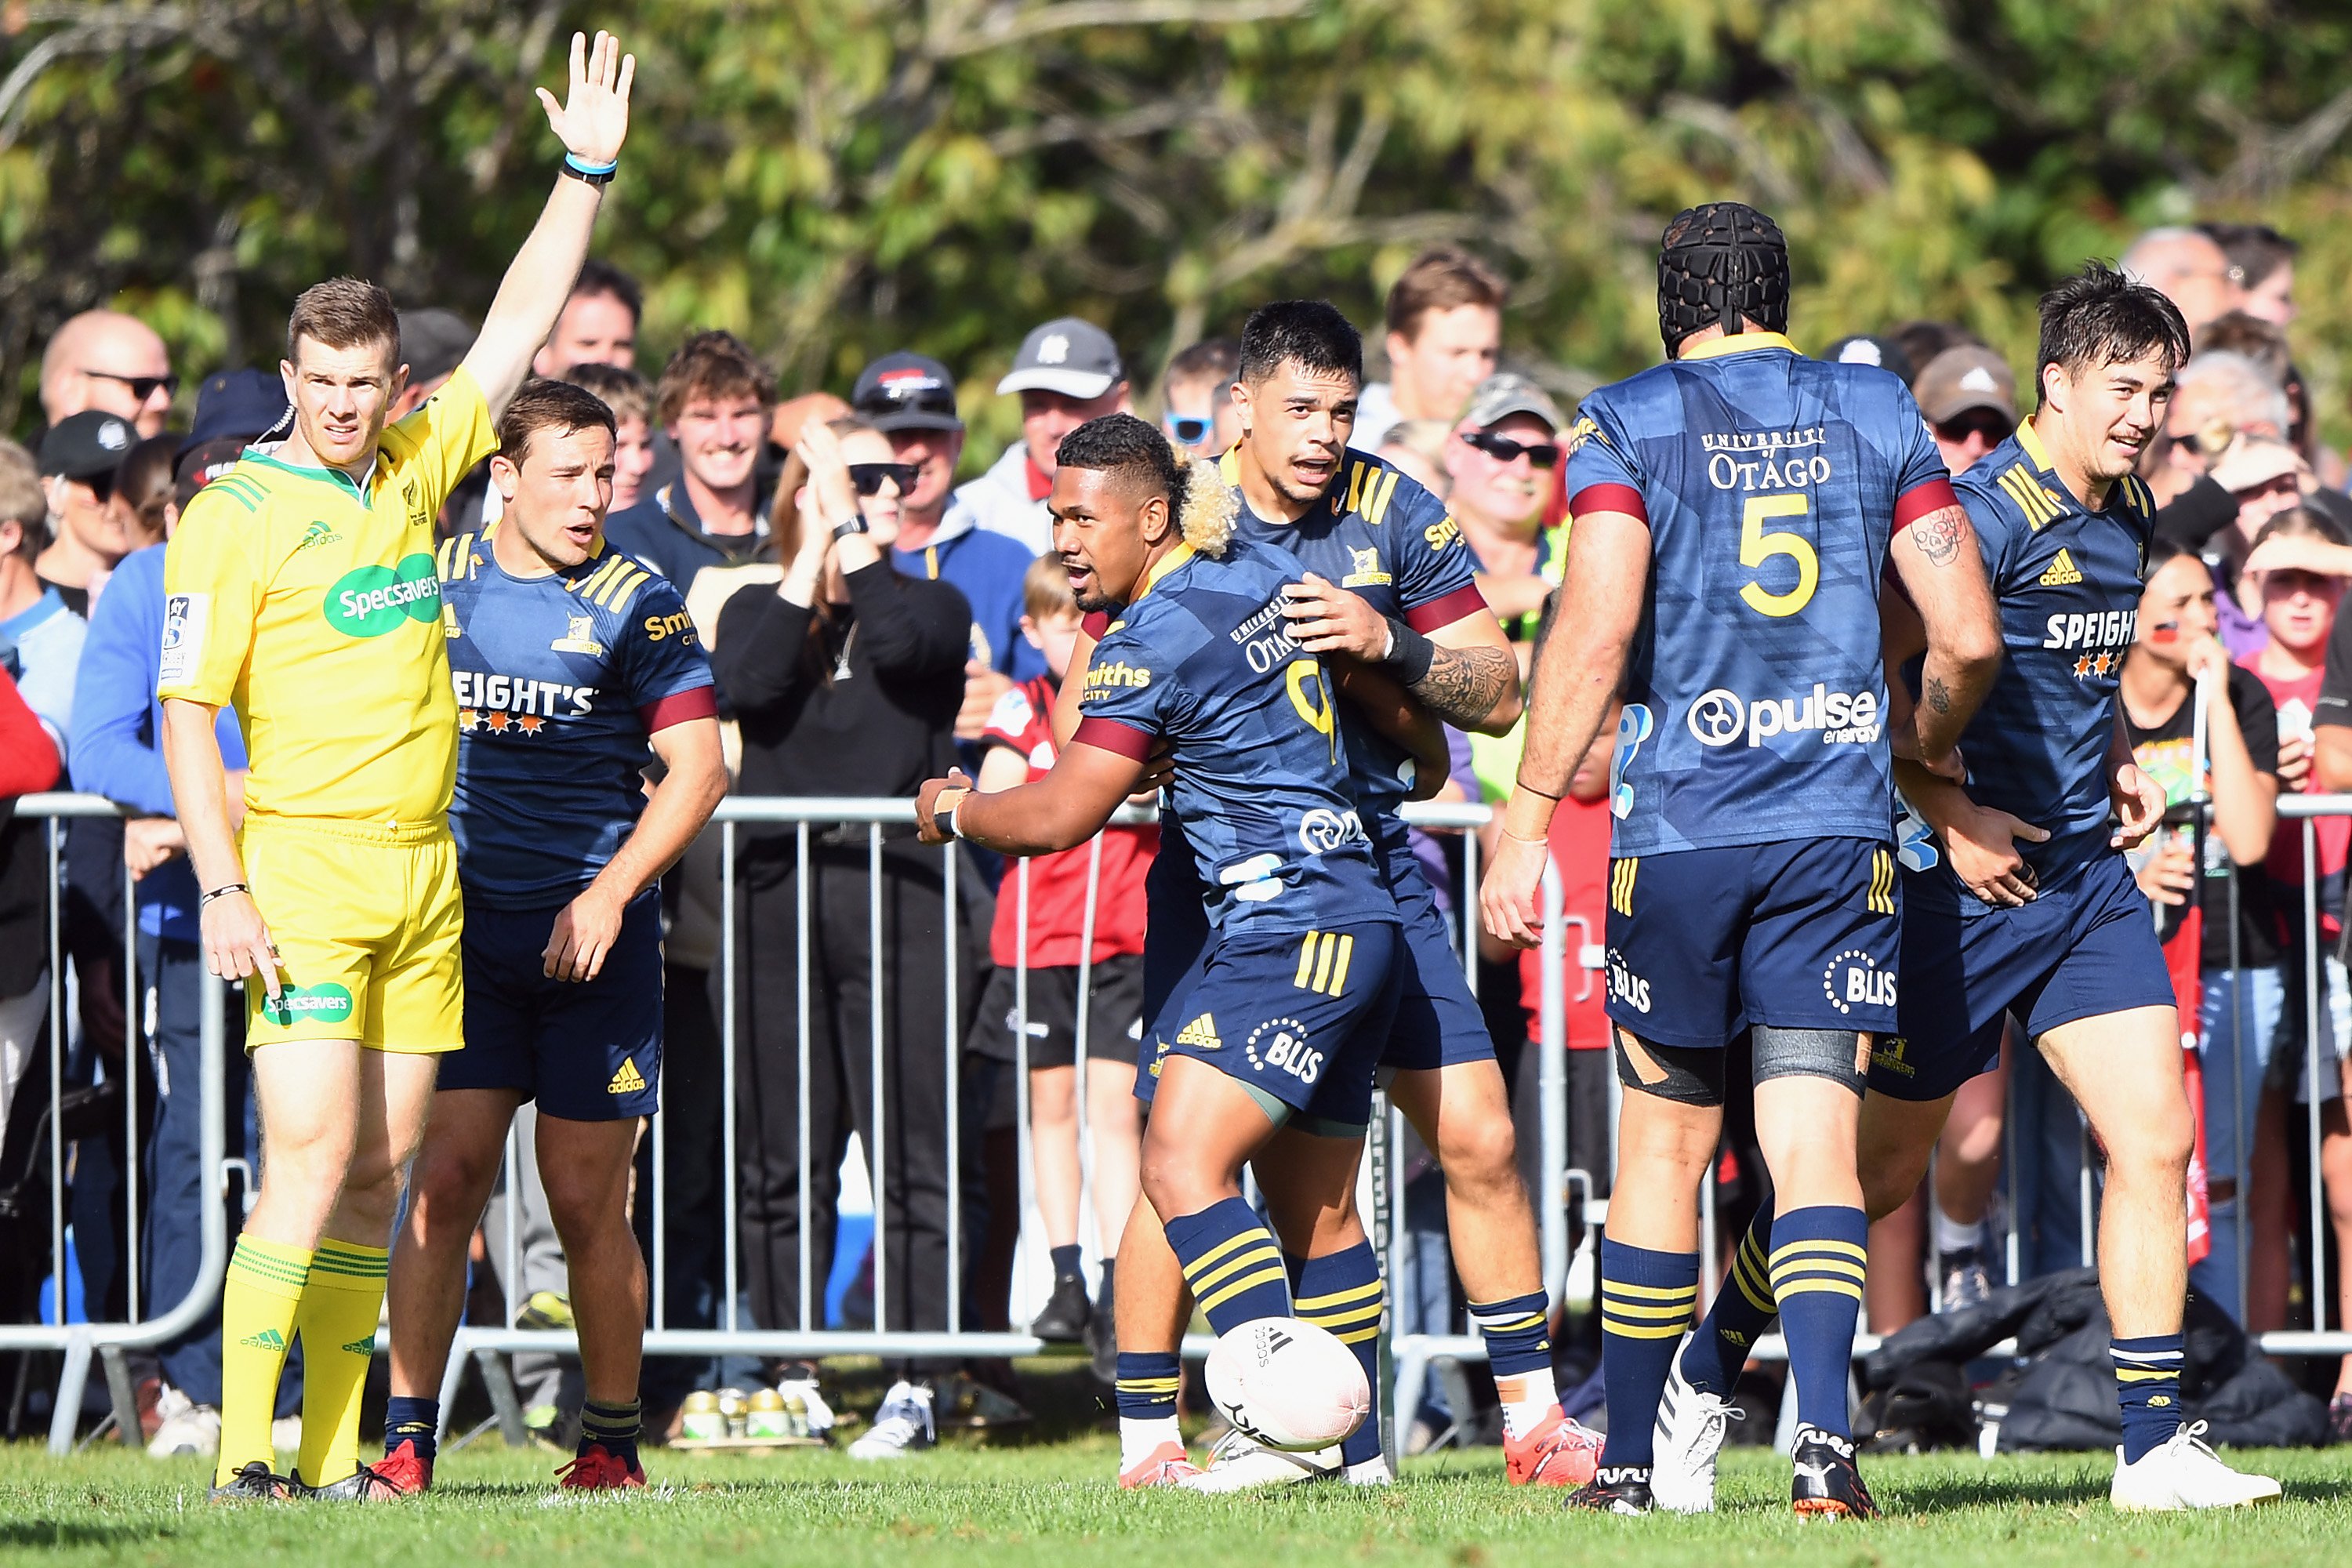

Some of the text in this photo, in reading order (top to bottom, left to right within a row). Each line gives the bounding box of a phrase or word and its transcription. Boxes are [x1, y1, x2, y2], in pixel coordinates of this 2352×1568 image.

[1708, 452, 1831, 491] OTAGO
[1739, 493, 1820, 618] 5
[2039, 570, 2083, 586] adidas
[339, 575, 440, 620] Specsavers
[644, 604, 691, 641] Smi
[452, 671, 593, 717] EIGHT'S
[1084, 661, 1151, 690] miths
[1084, 690, 1111, 701] CITY
[1286, 659, 1338, 766] 9
[1748, 683, 1877, 747] pulse
[1823, 724, 1881, 744] energy
[265, 994, 347, 1017] Specsavers
[1610, 964, 1651, 1014] BLIS
[1846, 967, 1897, 1007] BLIS
[1176, 1033, 1221, 1049] adidas
[1265, 1032, 1323, 1084] BLIS
[608, 1078, 646, 1094] adidas
[1595, 1467, 1653, 1489] FUTU
